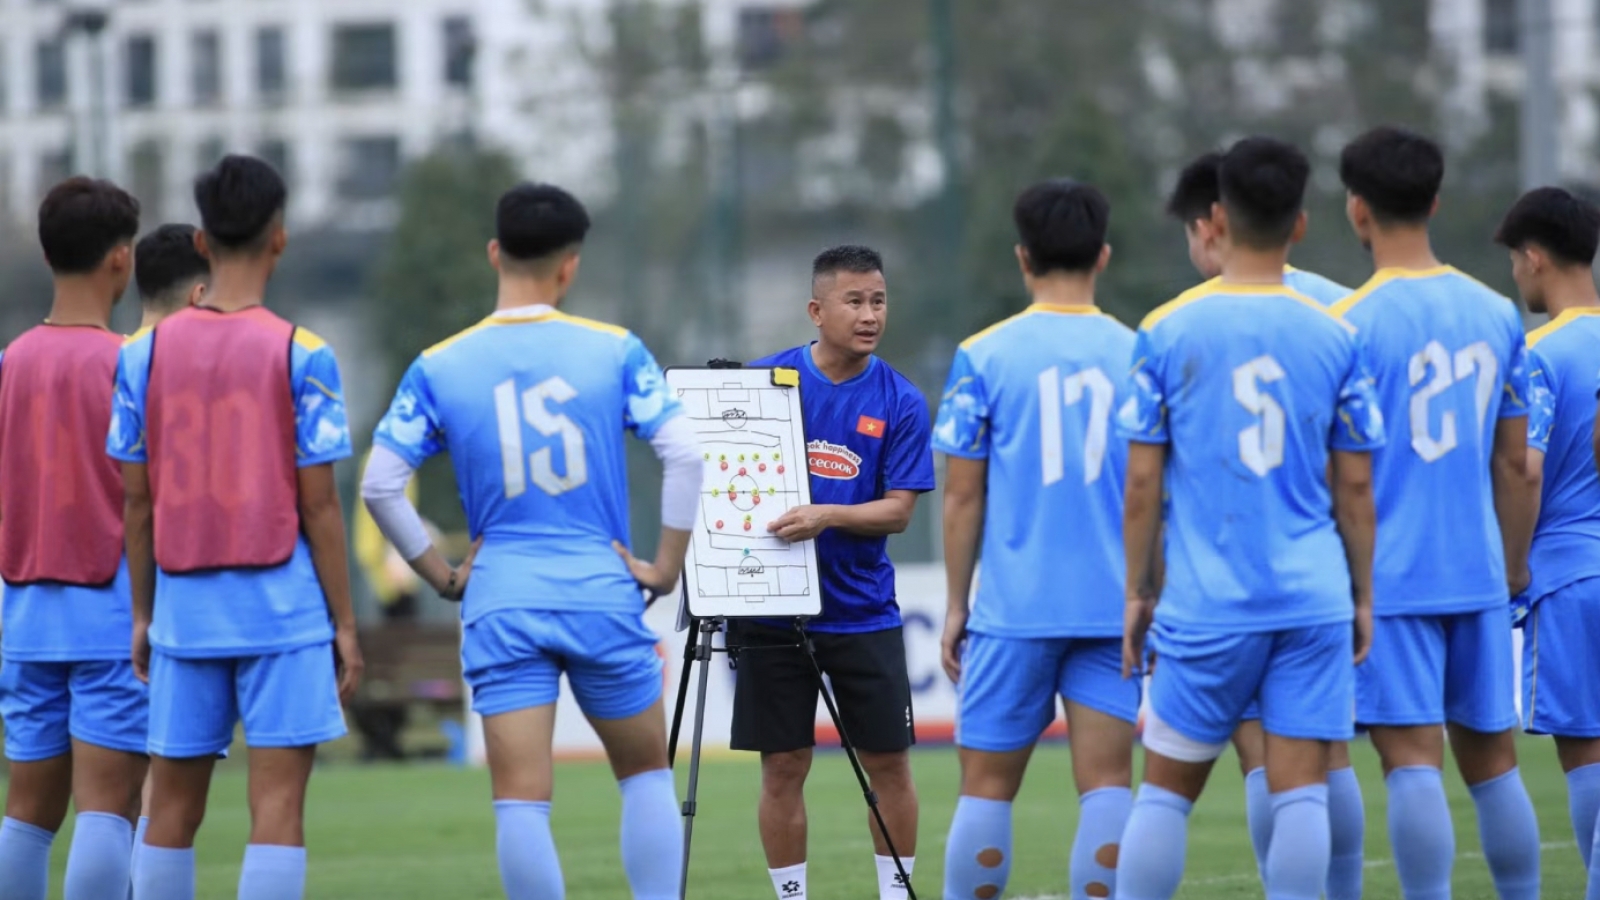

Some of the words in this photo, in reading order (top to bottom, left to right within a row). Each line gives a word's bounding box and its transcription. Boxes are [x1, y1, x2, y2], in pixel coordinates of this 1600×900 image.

[162, 388, 262, 512] 30
[493, 375, 589, 500] 15
[1037, 364, 1115, 487] 17
[1231, 354, 1286, 478] 5
[1408, 339, 1498, 463] 27
